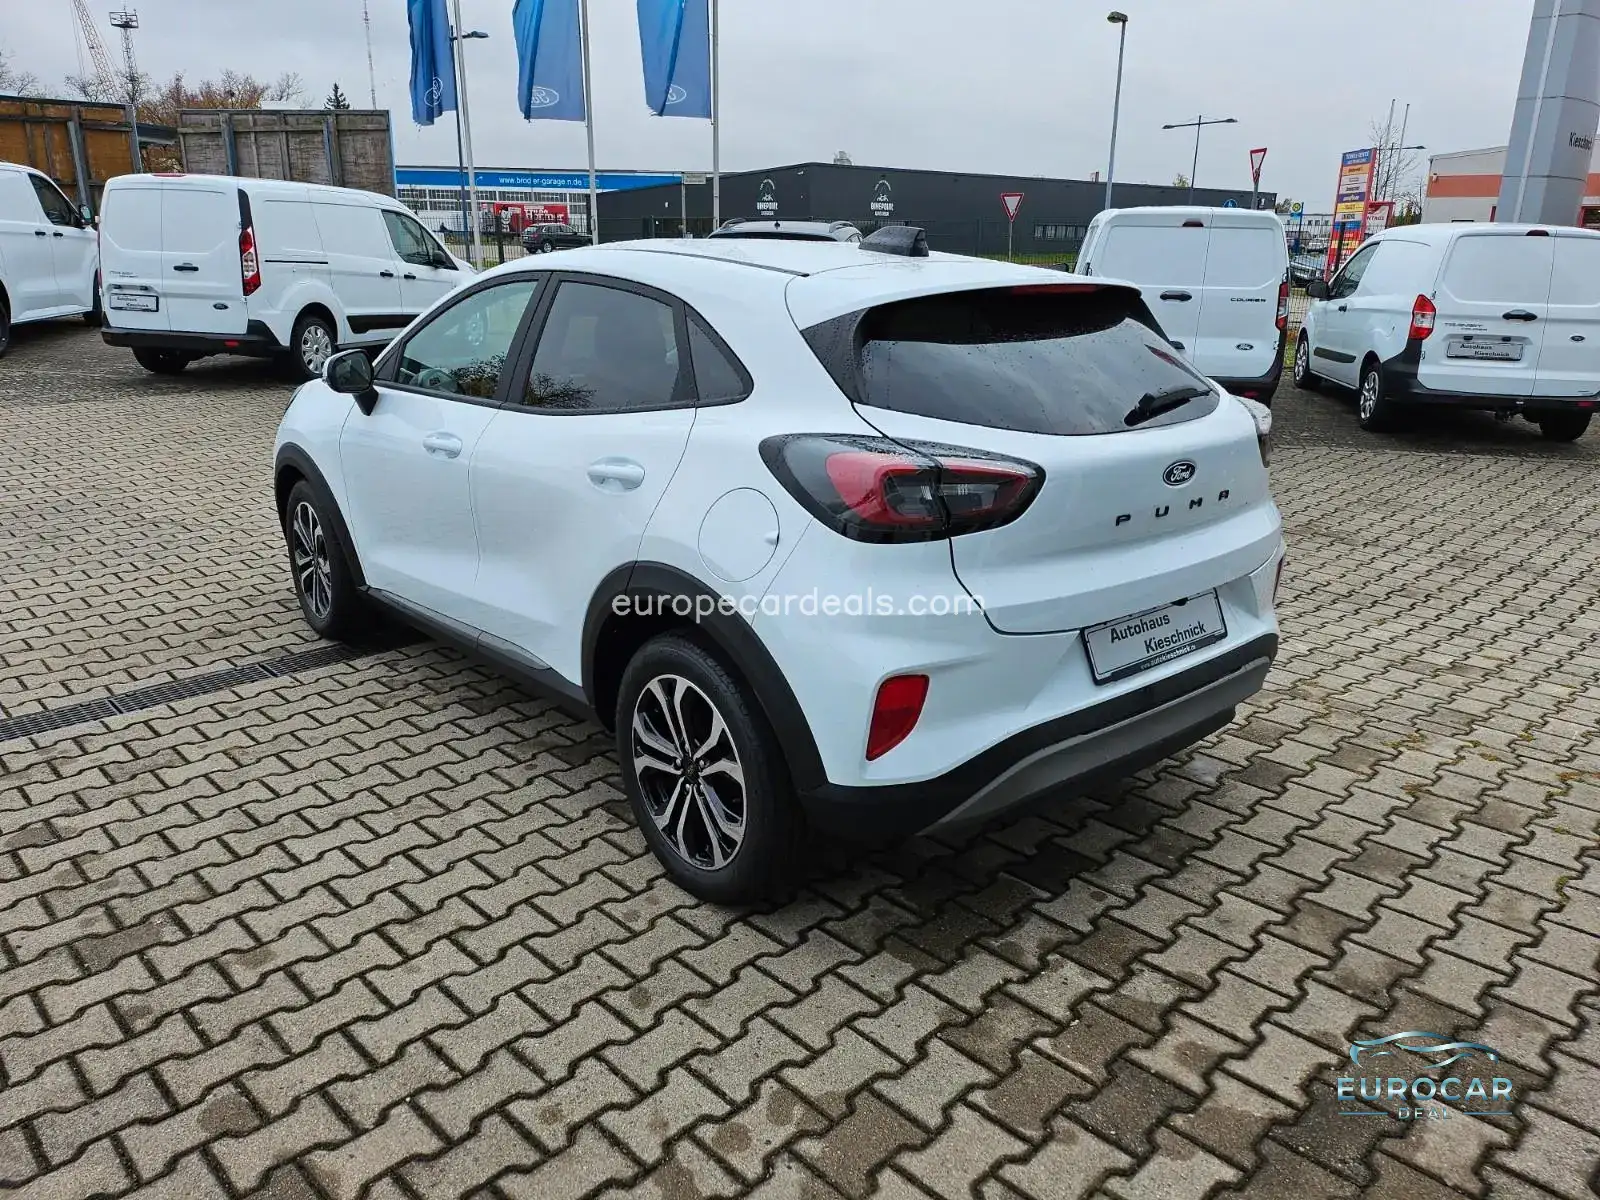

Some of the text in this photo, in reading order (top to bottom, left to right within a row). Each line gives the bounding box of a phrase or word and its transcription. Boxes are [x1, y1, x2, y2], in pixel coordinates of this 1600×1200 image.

[1170, 465, 1192, 482] Ford
[1115, 489, 1230, 527] PUMA
[1110, 614, 1171, 643] Autohaus
[1143, 620, 1207, 654] Kieschnick
